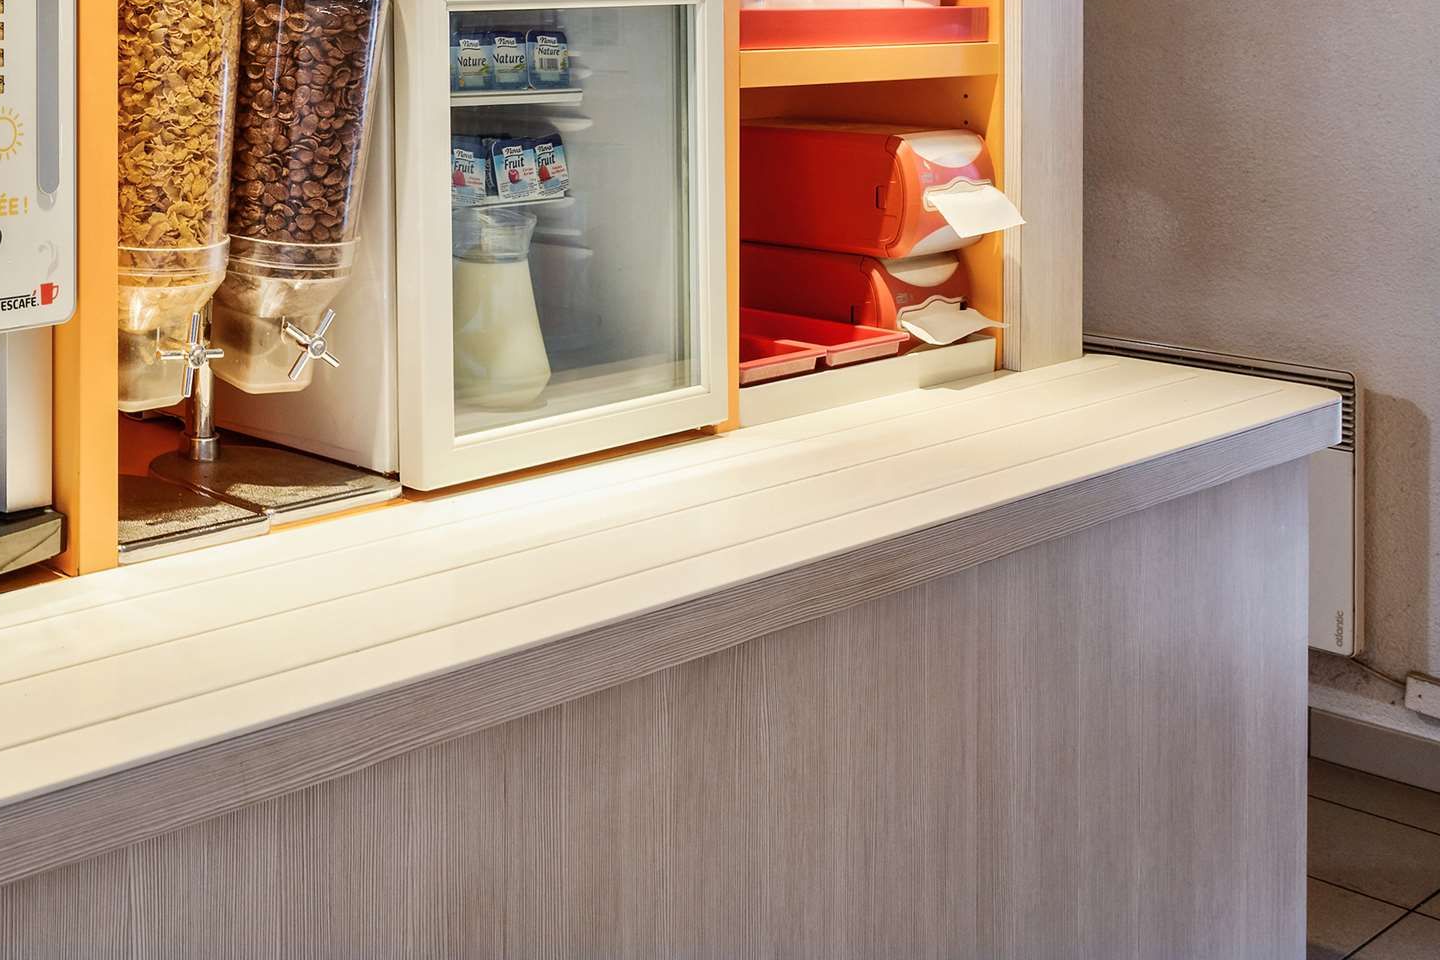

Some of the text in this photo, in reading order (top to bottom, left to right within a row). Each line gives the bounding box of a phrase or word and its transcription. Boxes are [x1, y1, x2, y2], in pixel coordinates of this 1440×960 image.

[538, 47, 560, 56] Nature
[458, 56, 486, 67] Nature
[493, 53, 525, 64] Nature
[454, 160, 475, 174] Fruit
[504, 157, 525, 170] Fruit
[538, 154, 556, 167] Fruit
[1335, 610, 1344, 648] atlantic
